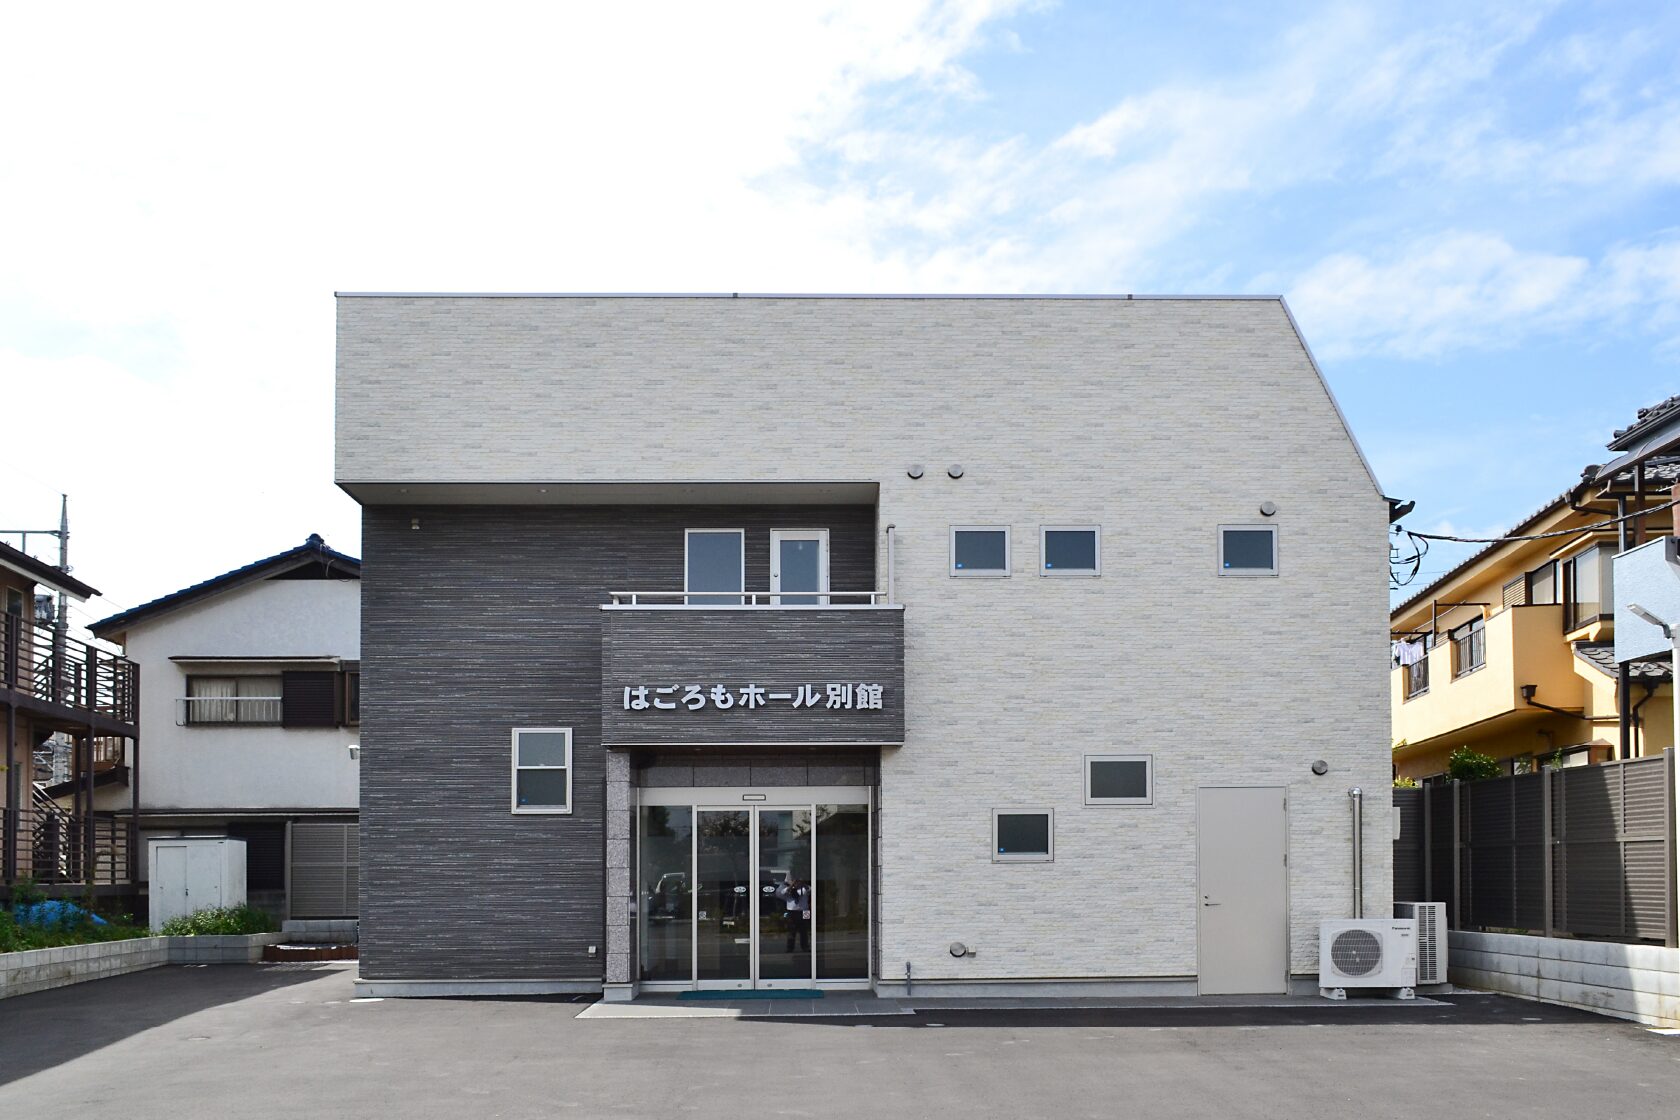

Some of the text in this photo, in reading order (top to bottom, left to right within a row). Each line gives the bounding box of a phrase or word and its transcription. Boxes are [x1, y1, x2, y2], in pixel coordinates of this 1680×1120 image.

[623, 683, 884, 710] はごろもホール別館
